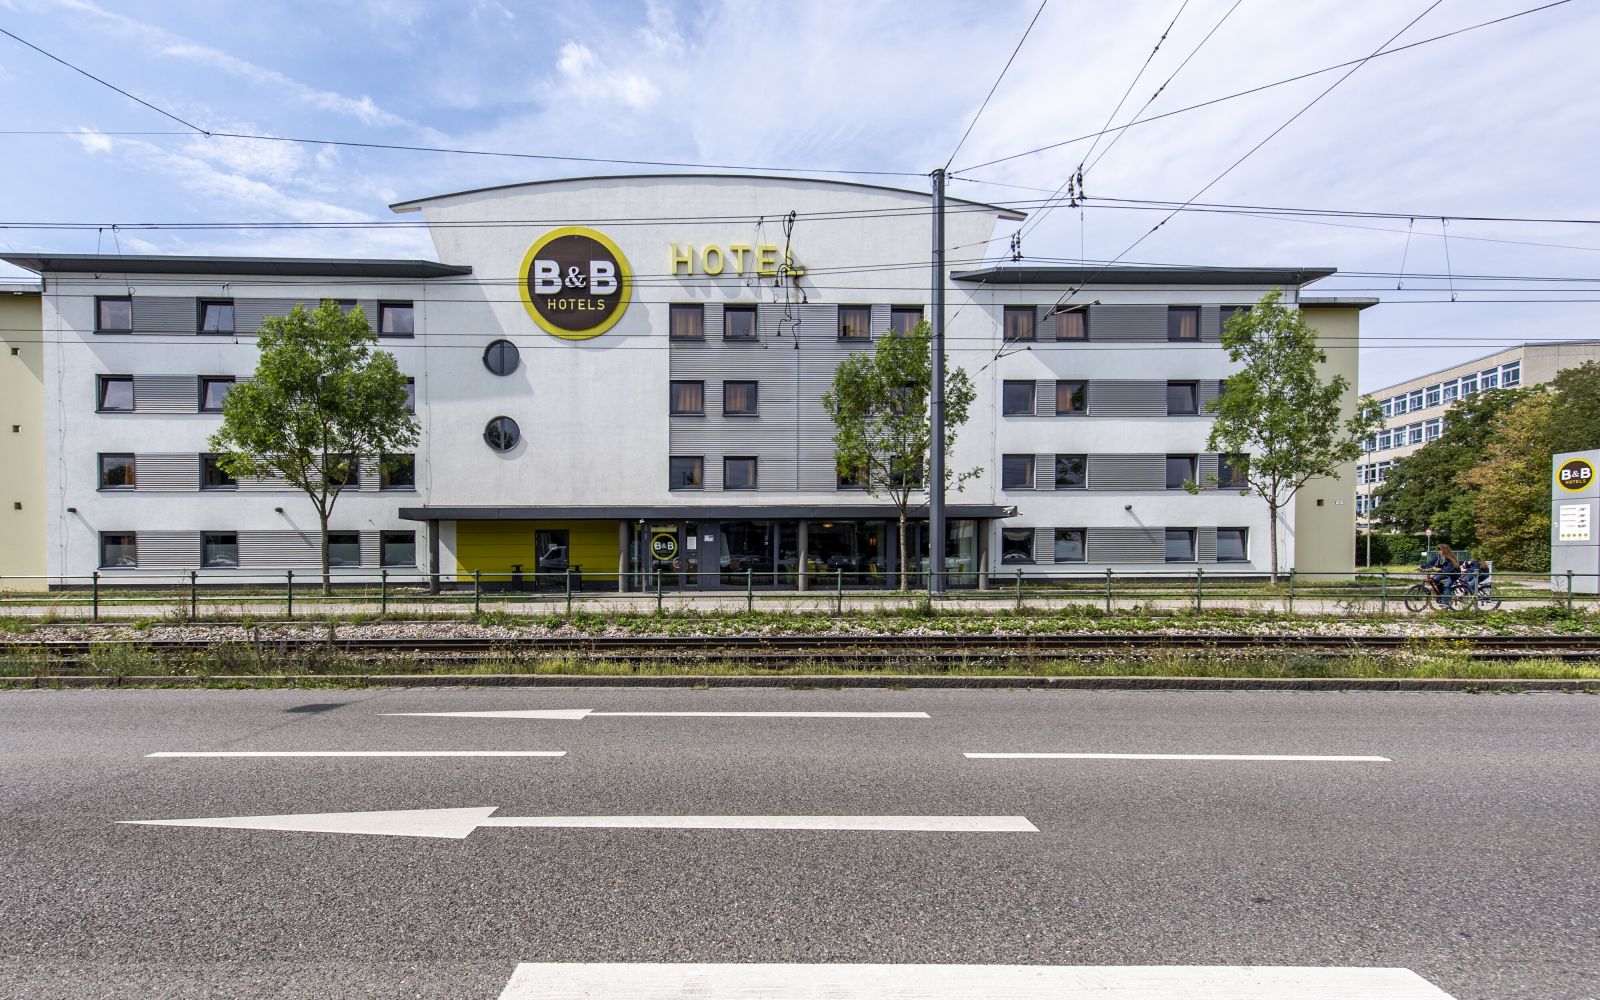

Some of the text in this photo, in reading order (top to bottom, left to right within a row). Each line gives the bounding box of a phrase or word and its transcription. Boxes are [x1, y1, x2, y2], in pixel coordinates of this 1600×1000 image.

[669, 243, 805, 277] HOTEL
[534, 259, 618, 295] B&B
[547, 298, 606, 311] HOTELS
[1561, 467, 1591, 480] B&B
[653, 541, 674, 550] B&B
